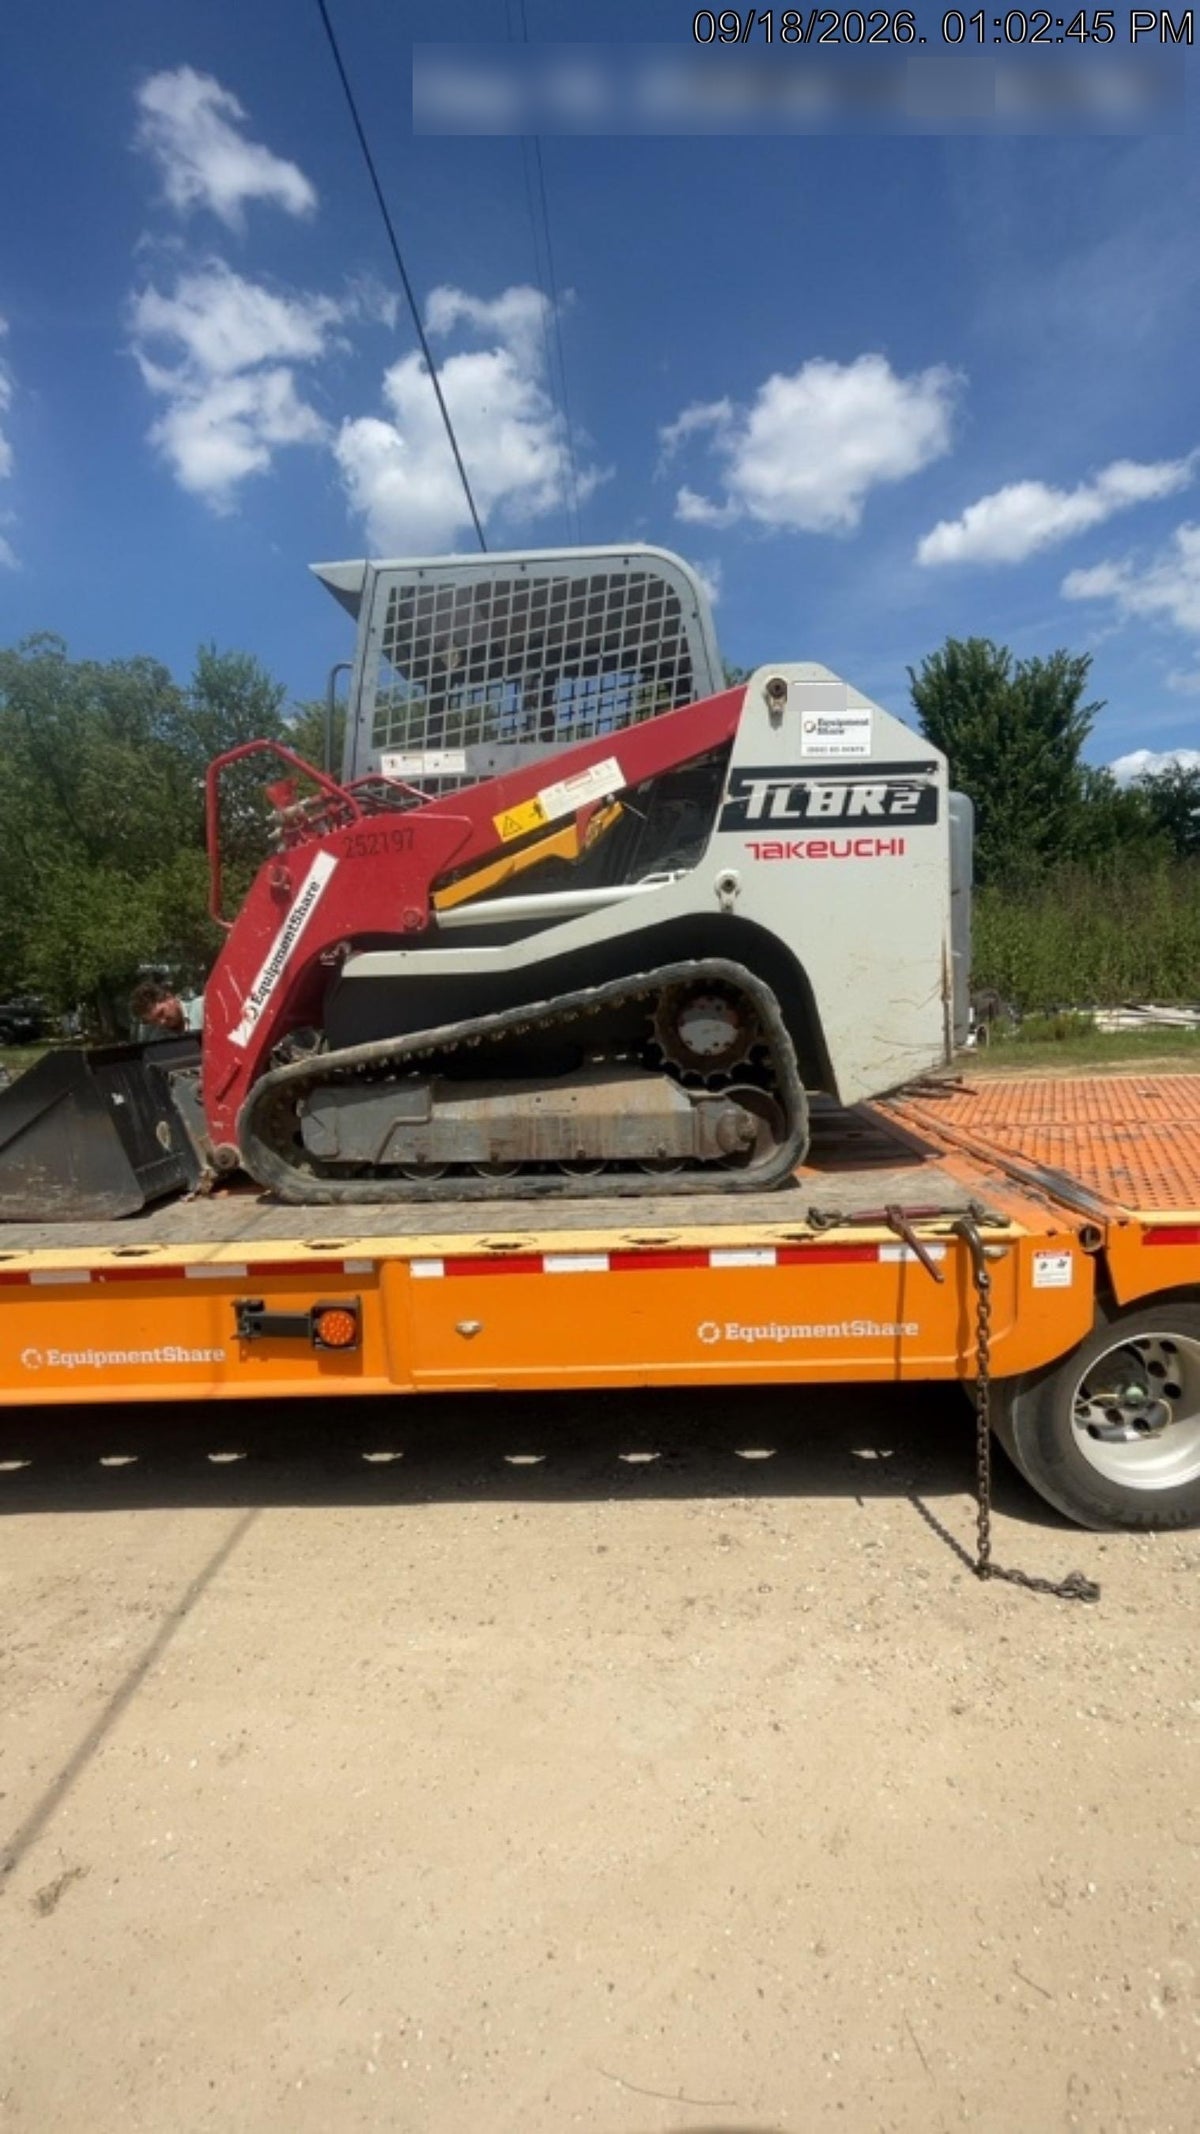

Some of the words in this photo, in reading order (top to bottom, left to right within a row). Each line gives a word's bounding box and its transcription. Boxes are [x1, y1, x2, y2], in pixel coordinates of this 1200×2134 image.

[251, 880, 320, 1007] EquipmentShare
[725, 1319, 919, 1343] EquipmentShare
[46, 1346, 226, 1369] EquipmentShare
